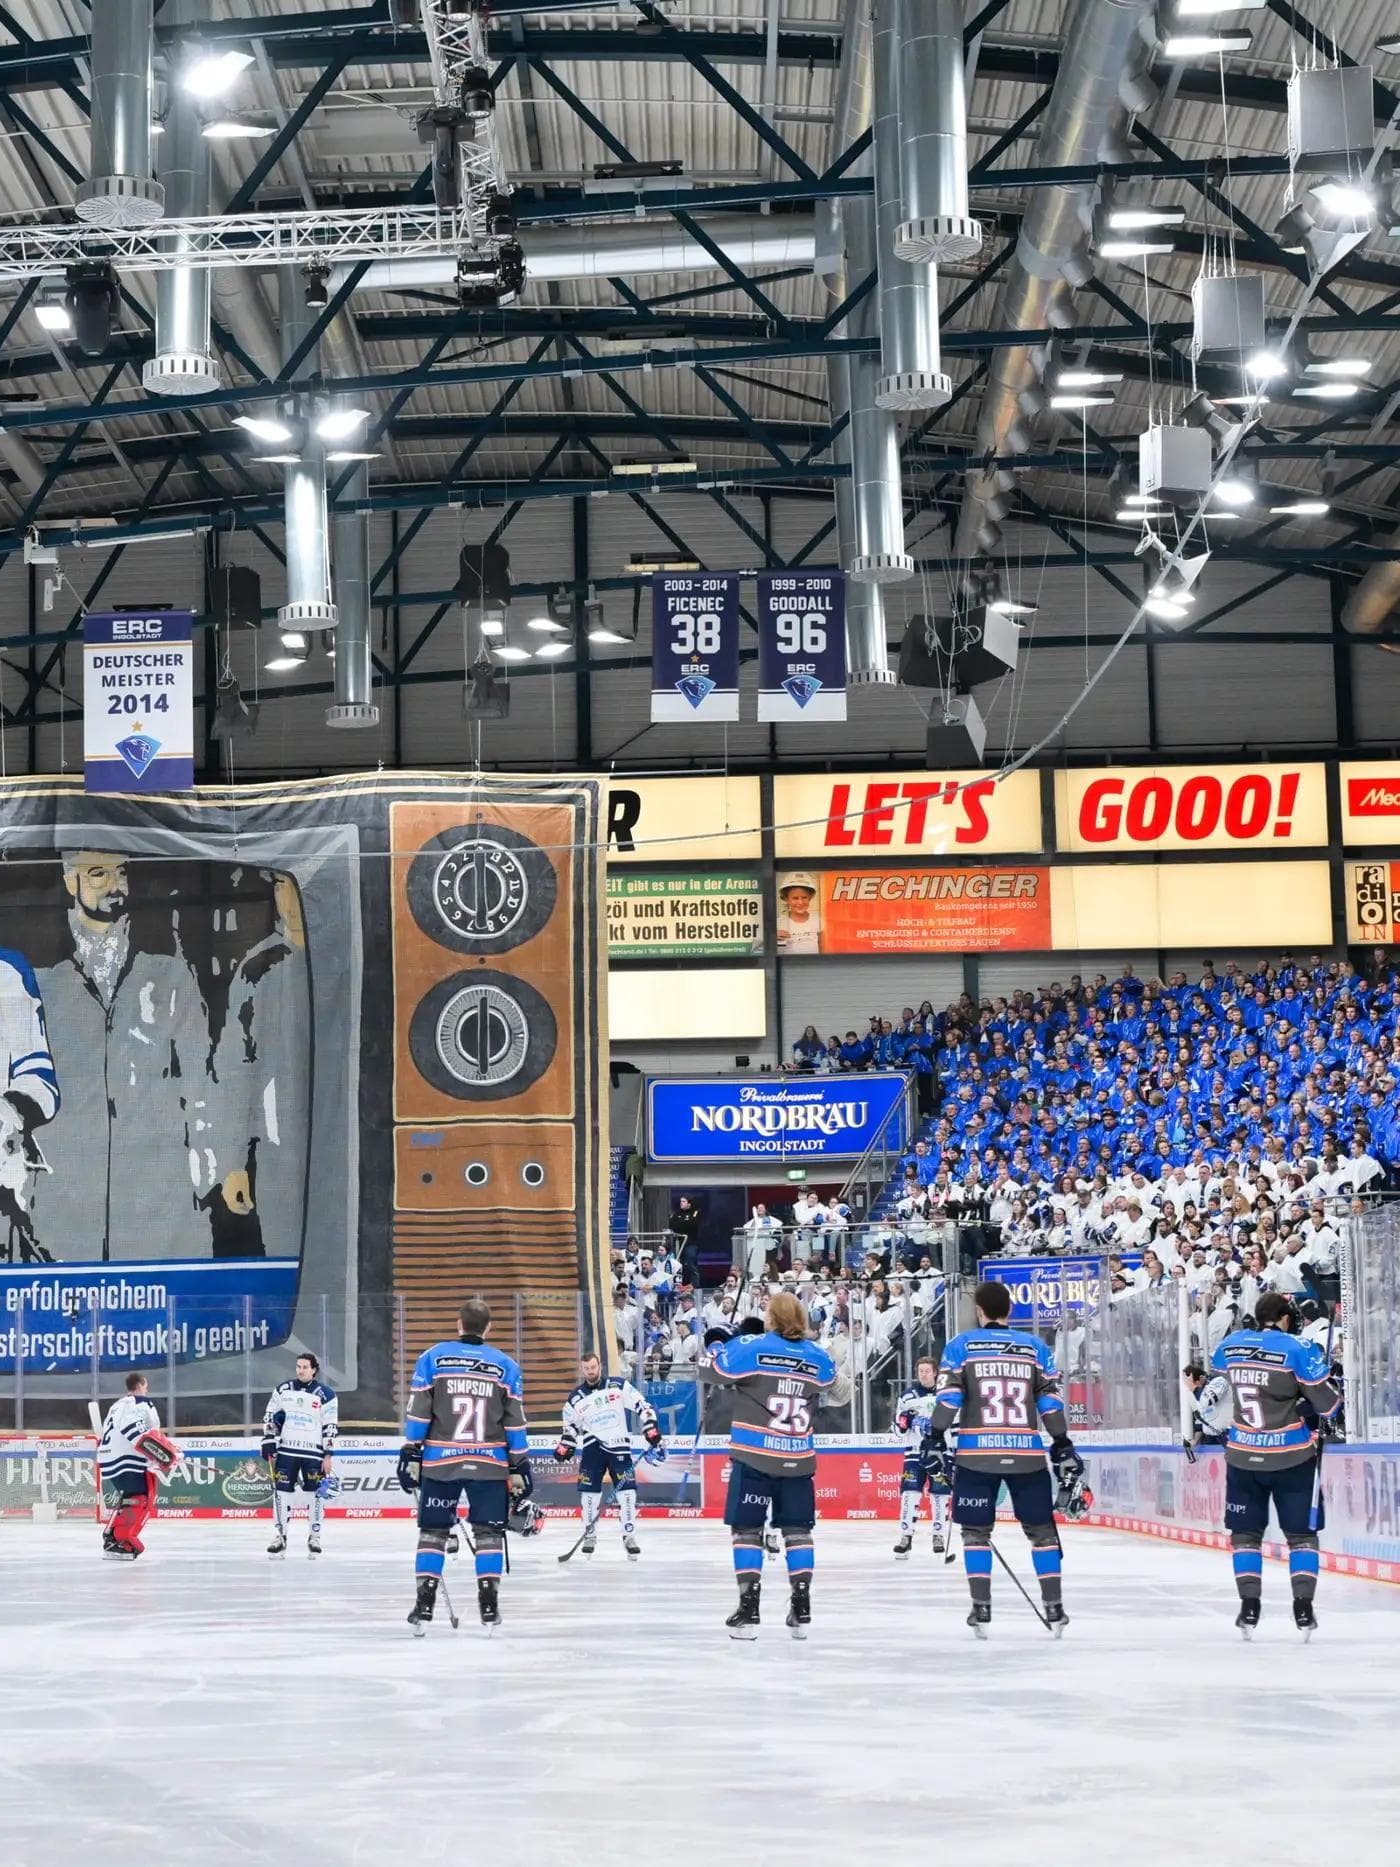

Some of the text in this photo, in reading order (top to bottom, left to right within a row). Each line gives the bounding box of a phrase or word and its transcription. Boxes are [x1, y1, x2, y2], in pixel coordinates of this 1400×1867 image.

[668, 596, 724, 612] FICENEC
[769, 596, 832, 612] GOODALL
[112, 619, 163, 634] ERC
[670, 614, 721, 654] 38
[776, 613, 826, 654] 96
[92, 654, 184, 668] DEUTSCHER
[680, 664, 710, 672] ERC
[787, 664, 816, 672] ERC
[101, 672, 175, 688] MEISTER
[108, 693, 170, 715] 2014
[824, 780, 995, 847] LET'S
[1078, 772, 1300, 843] GOOO!
[628, 880, 648, 893] gibt
[652, 880, 664, 891] es
[668, 880, 686, 891] nur
[690, 878, 700, 890] in
[704, 878, 722, 890] der
[726, 878, 758, 890] Arena
[832, 874, 1039, 901] HECHINGER
[634, 900, 664, 918] und
[670, 899, 758, 917] Kraftstoffe
[1017, 901, 1037, 910] 1950
[632, 926, 668, 940] vom
[676, 922, 759, 940] Hersteller
[690, 1102, 868, 1136] NORDBRÄU
[740, 1140, 826, 1152] INGOLSTADT
[6, 1279, 167, 1316] erfolgreichem
[194, 1320, 269, 1358] geehrt
[974, 1362, 1031, 1378] BERTRAND
[446, 1379, 494, 1398] SIMPSON
[980, 1380, 1028, 1425] 33
[1237, 1387, 1264, 1428] 5
[452, 1398, 488, 1442] 21
[768, 1397, 812, 1433] 25
[978, 1435, 1033, 1449] INGOLSTADT
[958, 1496, 988, 1507] JOOP!
